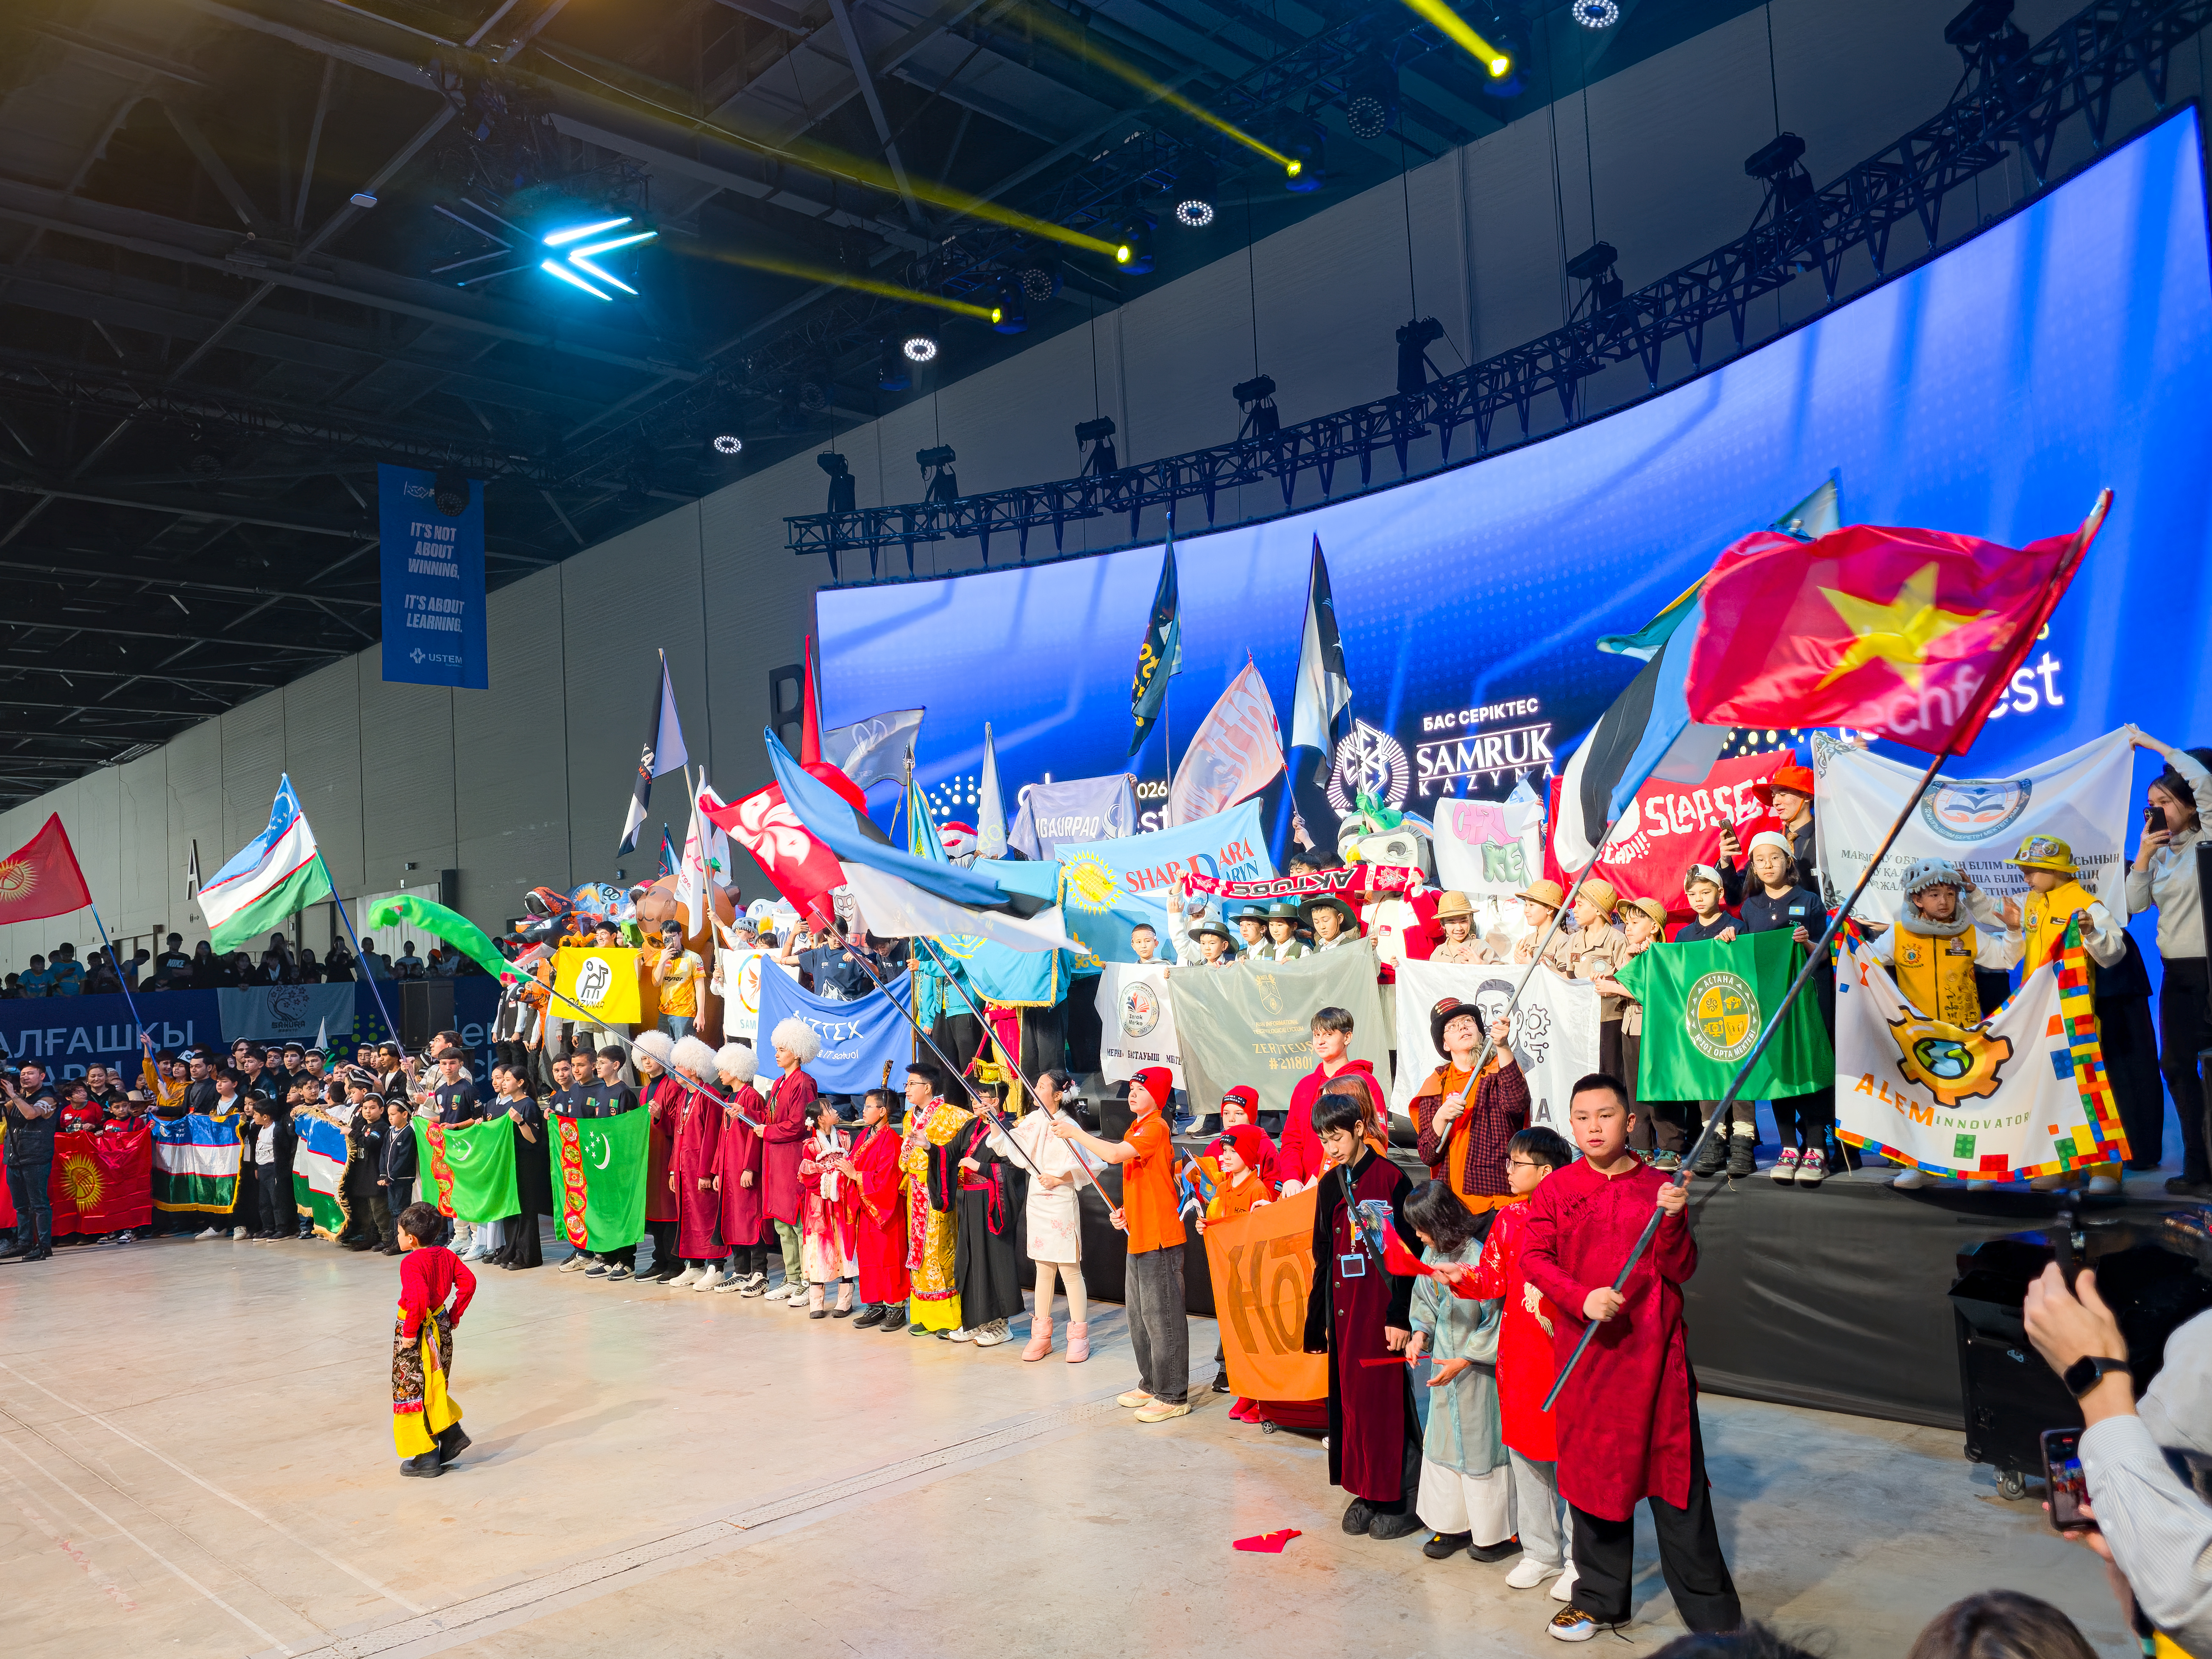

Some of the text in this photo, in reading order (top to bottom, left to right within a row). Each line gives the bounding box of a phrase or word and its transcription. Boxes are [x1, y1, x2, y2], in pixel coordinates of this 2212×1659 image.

[410, 522, 457, 542] IT'S NOT
[414, 541, 454, 559] ABOUT
[408, 558, 459, 580] WINNING,
[404, 594, 465, 615] IT'S ABOUT
[406, 612, 462, 633] LEARNING.
[428, 653, 462, 664] USTEM
[1423, 698, 1539, 731] БАС СЕРІКТЕС
[1416, 727, 1553, 777] SAMRUK
[1418, 763, 1555, 796] KAZYNA
[1703, 975, 1733, 988] АСТАНА
[1713, 1048, 1733, 1058] ОРТА
[1733, 1029, 1756, 1057] МЕКТЕБІ
[1127, 1050, 1160, 1062] БАСТАУЫШ
[1853, 1072, 1936, 1127] ALEM
